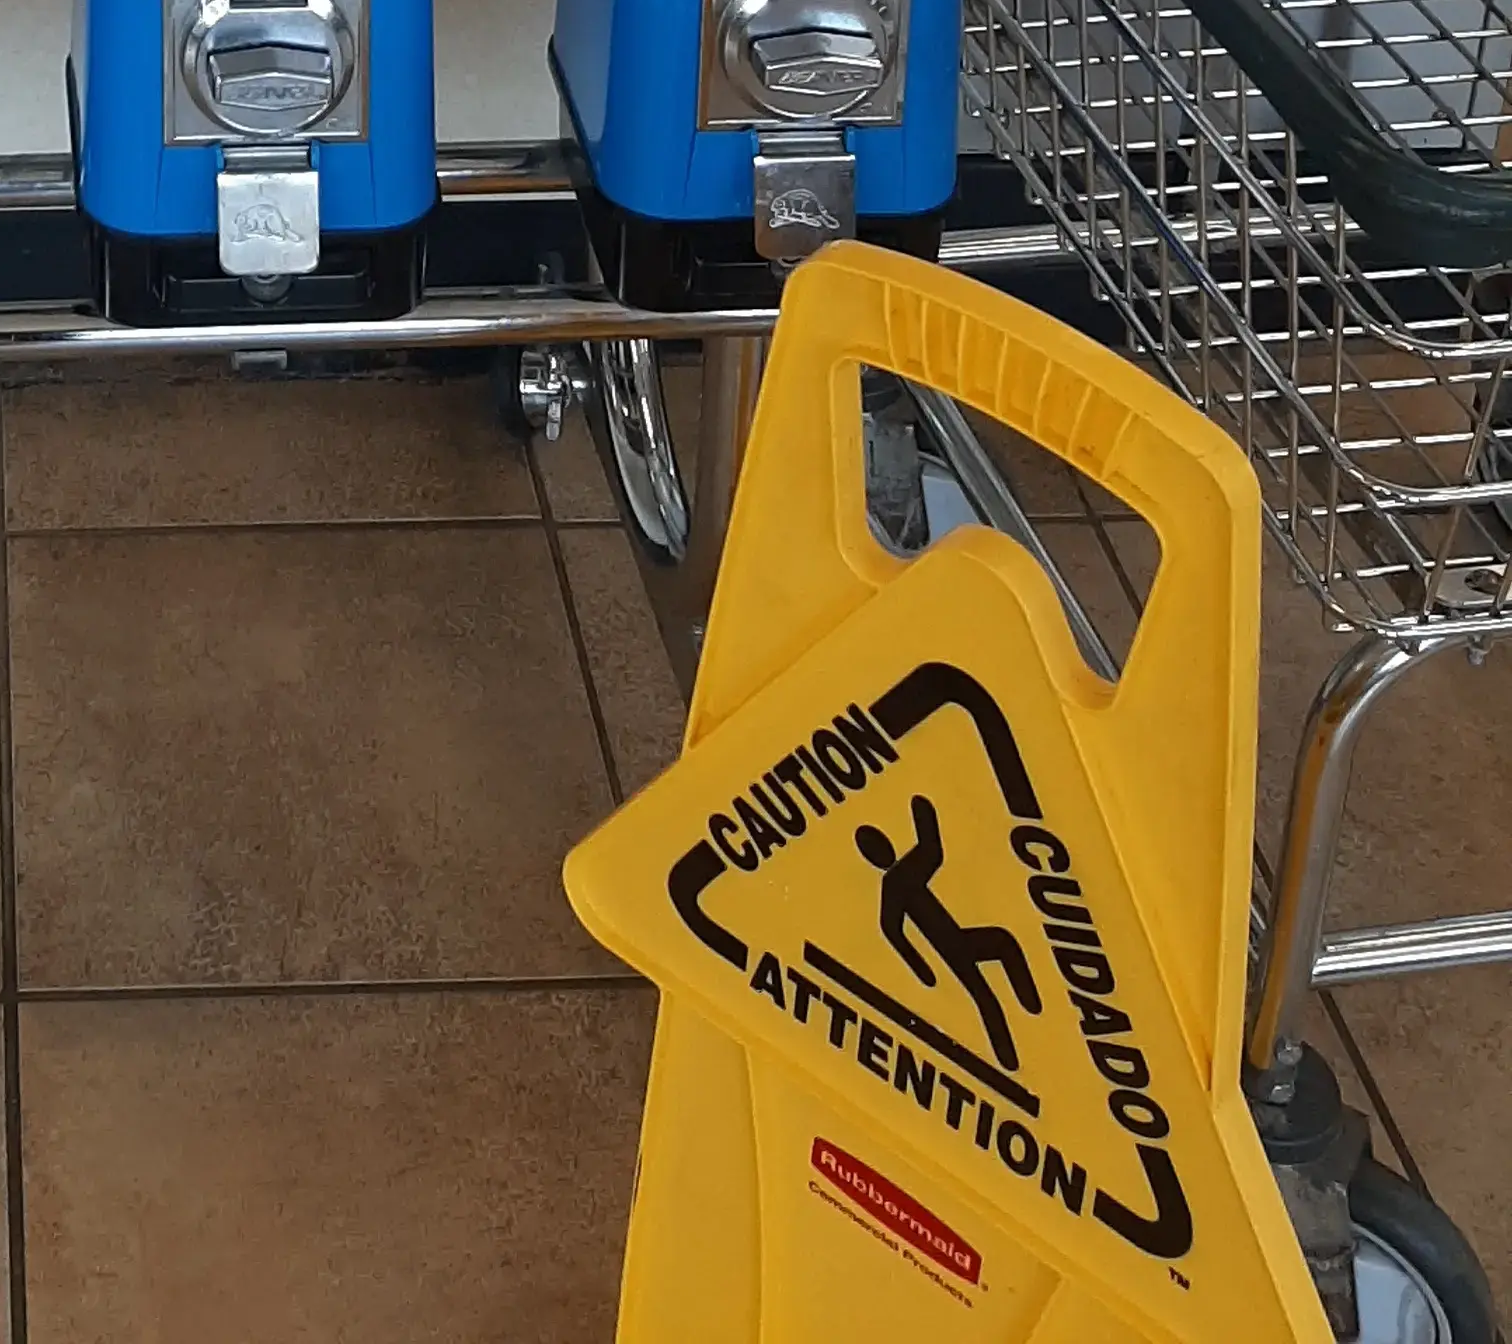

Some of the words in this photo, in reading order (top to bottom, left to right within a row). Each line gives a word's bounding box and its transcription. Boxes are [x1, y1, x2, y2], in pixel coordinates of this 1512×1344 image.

[706, 702, 901, 872] CAUTION
[1009, 824, 1171, 1140] CUIDADO
[748, 951, 1088, 1217] ATTENTION
[820, 1149, 972, 1271] Rubbermaid
[902, 1248, 974, 1309] Products
